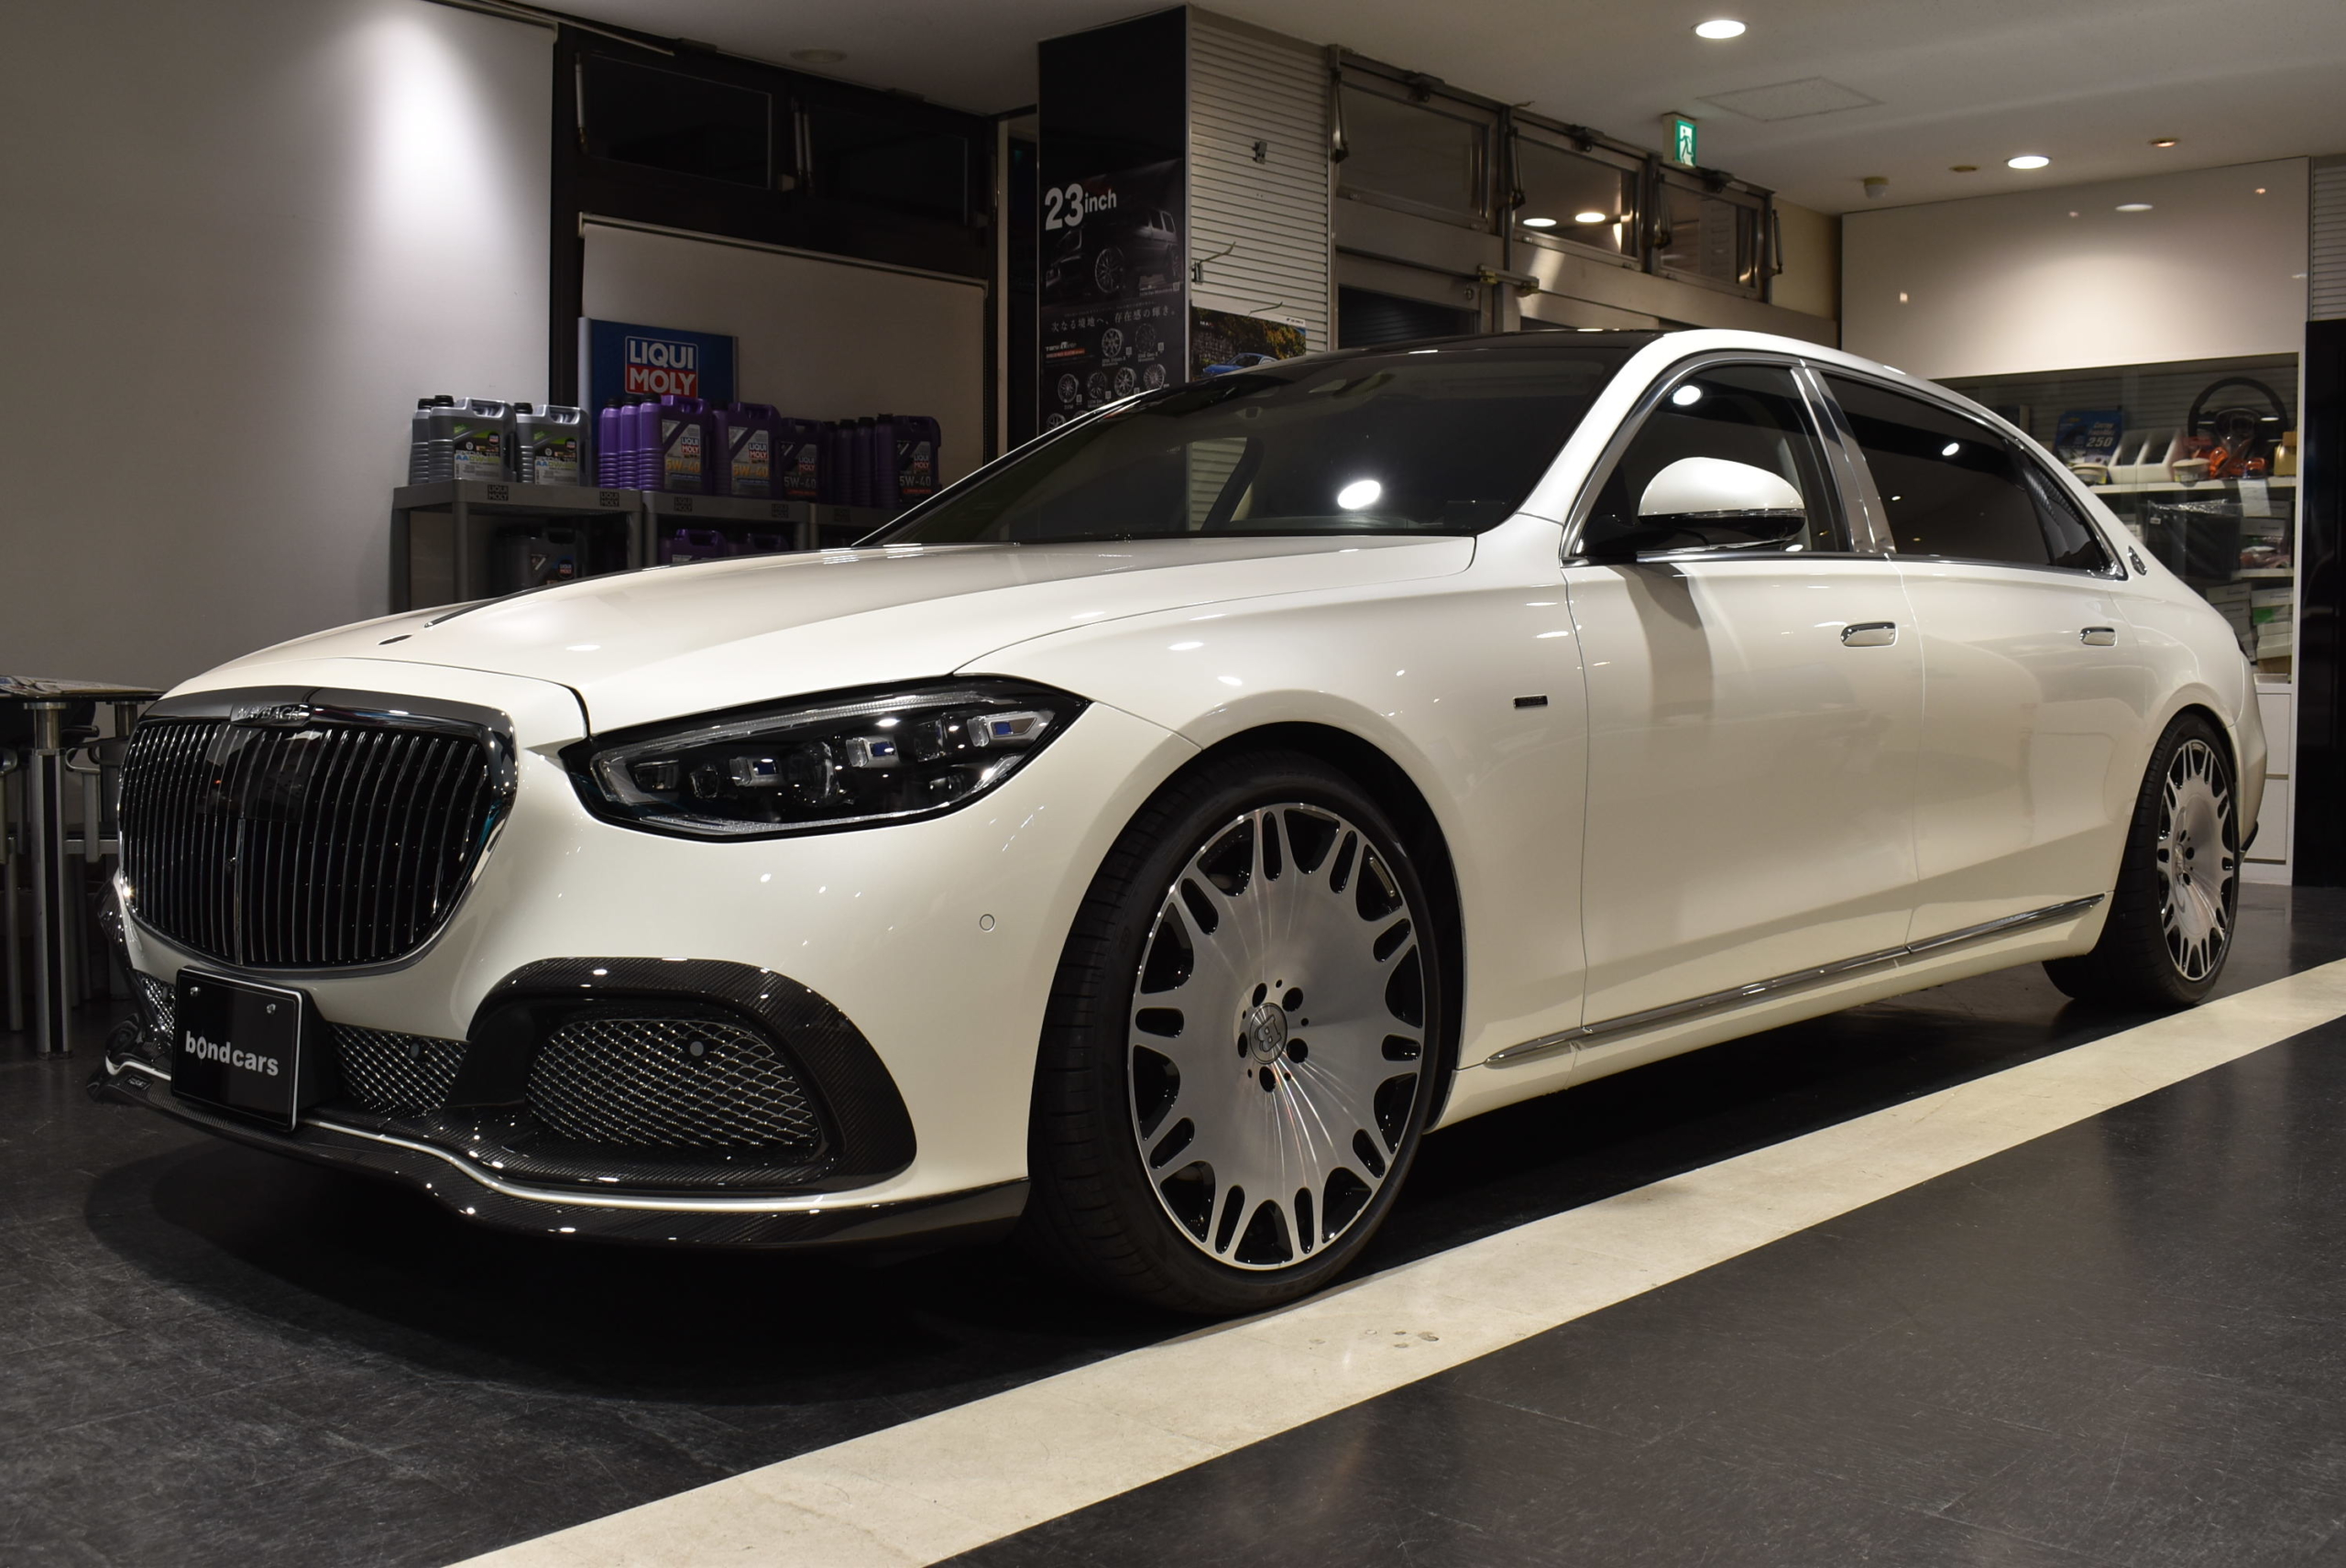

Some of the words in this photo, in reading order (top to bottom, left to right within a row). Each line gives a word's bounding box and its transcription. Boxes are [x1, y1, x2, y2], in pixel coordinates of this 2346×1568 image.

[630, 340, 694, 369] LIQUI
[630, 367, 696, 396] MOLY
[682, 437, 699, 445] LIQUI
[2085, 436, 2114, 447] 250
[682, 445, 699, 454] MOLY
[749, 451, 767, 459] MOLY
[666, 459, 700, 473] 5W-40
[733, 465, 769, 477] 5W-40
[784, 477, 817, 489] 5W-40
[899, 476, 931, 487] 5W-40
[488, 485, 508, 493] LIQUI
